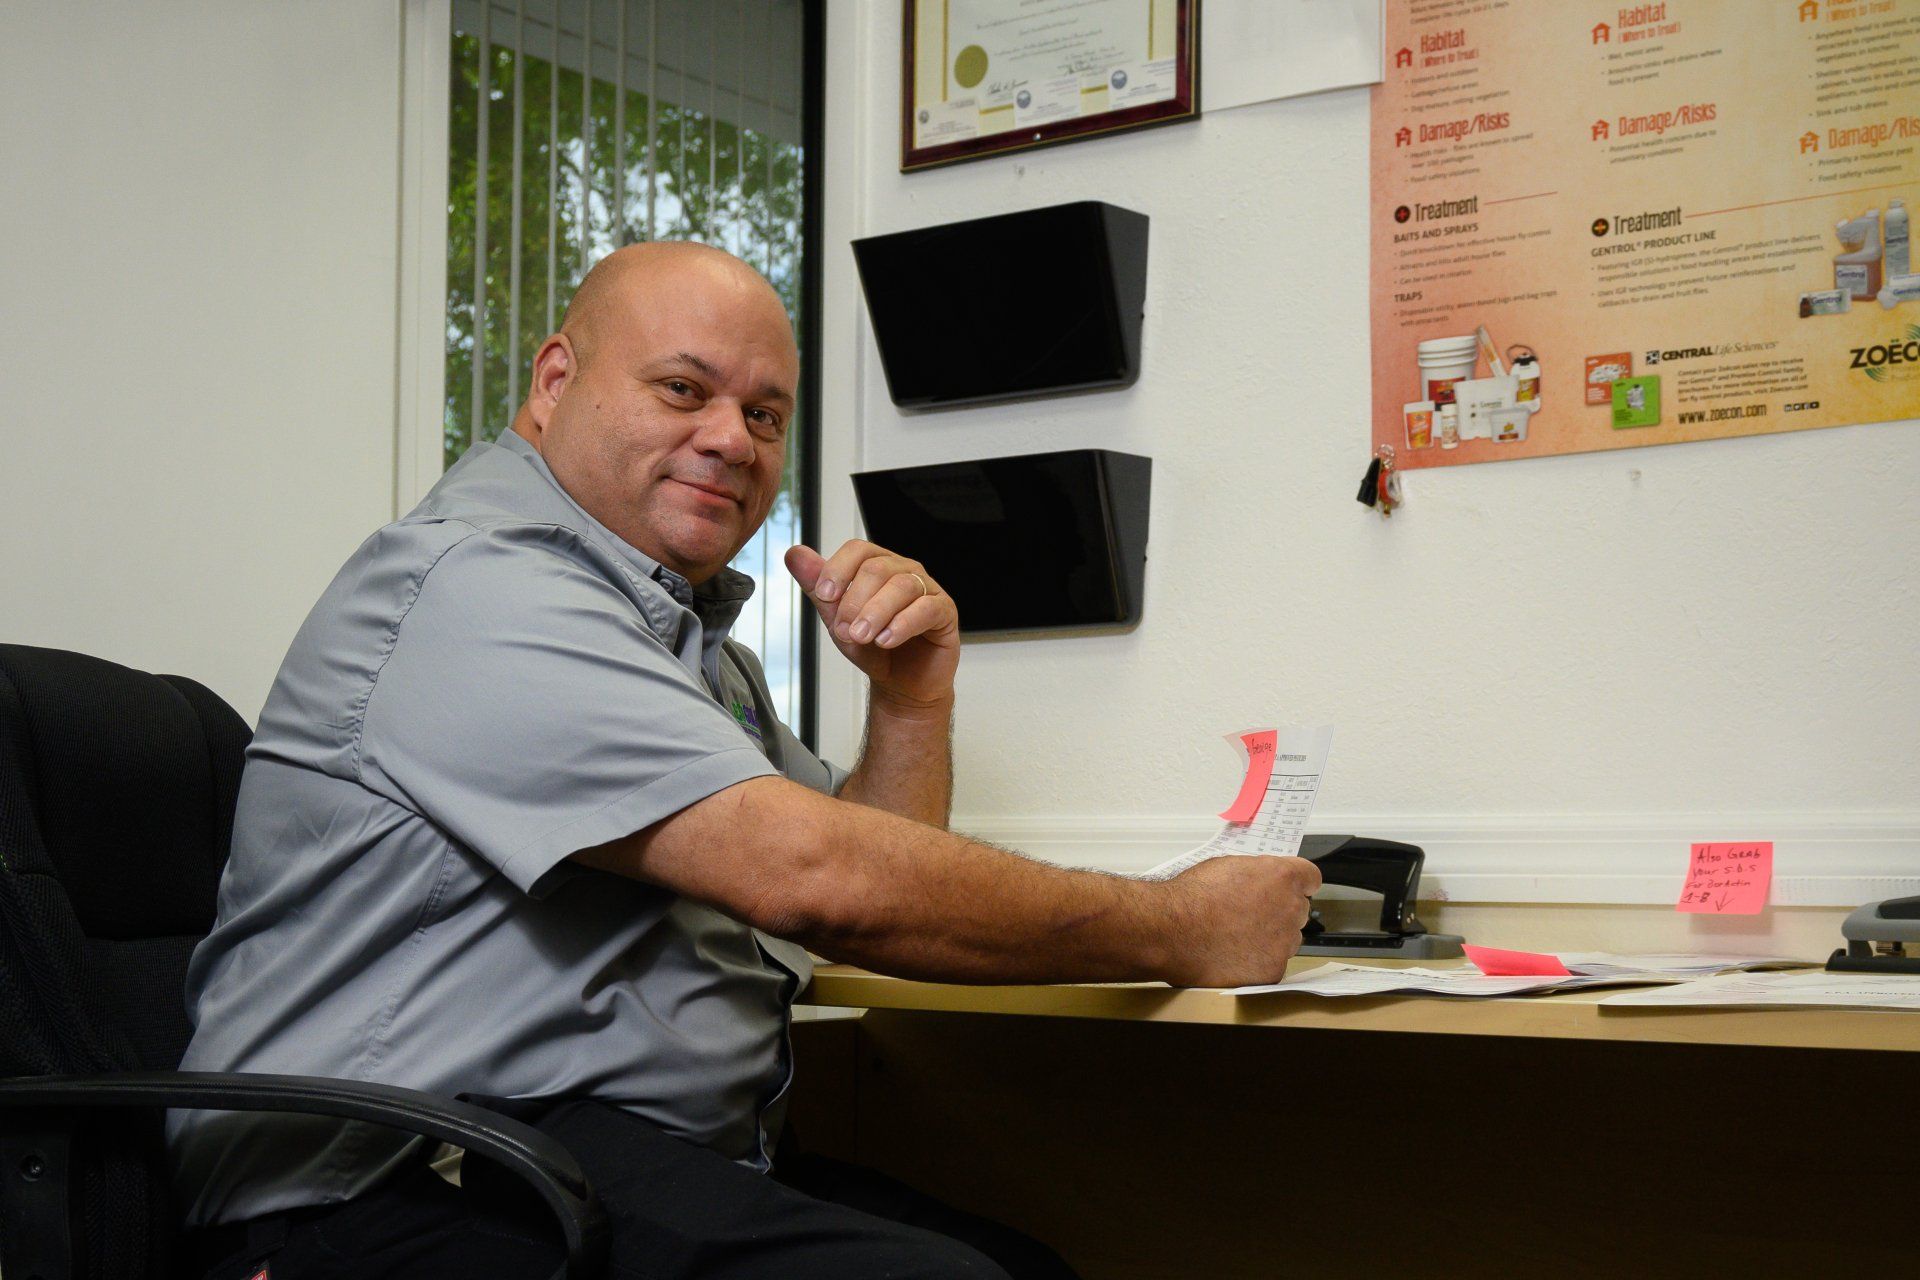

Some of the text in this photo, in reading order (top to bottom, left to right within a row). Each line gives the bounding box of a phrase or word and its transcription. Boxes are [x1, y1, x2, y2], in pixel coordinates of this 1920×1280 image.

[1618, 2, 1665, 29] Habitat
[1420, 28, 1466, 54] Habitat
[1419, 112, 1510, 143] Damage/Risks
[1619, 103, 1718, 137] Damage/Risks
[1415, 195, 1479, 222] Treatment
[1394, 222, 1479, 244] BAITS AND SPRAYS
[1614, 207, 1682, 235] Treatment
[1643, 233, 1693, 250] PRODUCT
[1694, 229, 1717, 243] LINE
[1837, 269, 1867, 280] Gentrol
[1394, 290, 1423, 303] TRAPS
[1811, 296, 1844, 306] Gentrol
[1662, 346, 1714, 361] CENTRAL
[1849, 338, 1920, 369] ZOËC
[1677, 403, 1768, 424] www.zoecon.com
